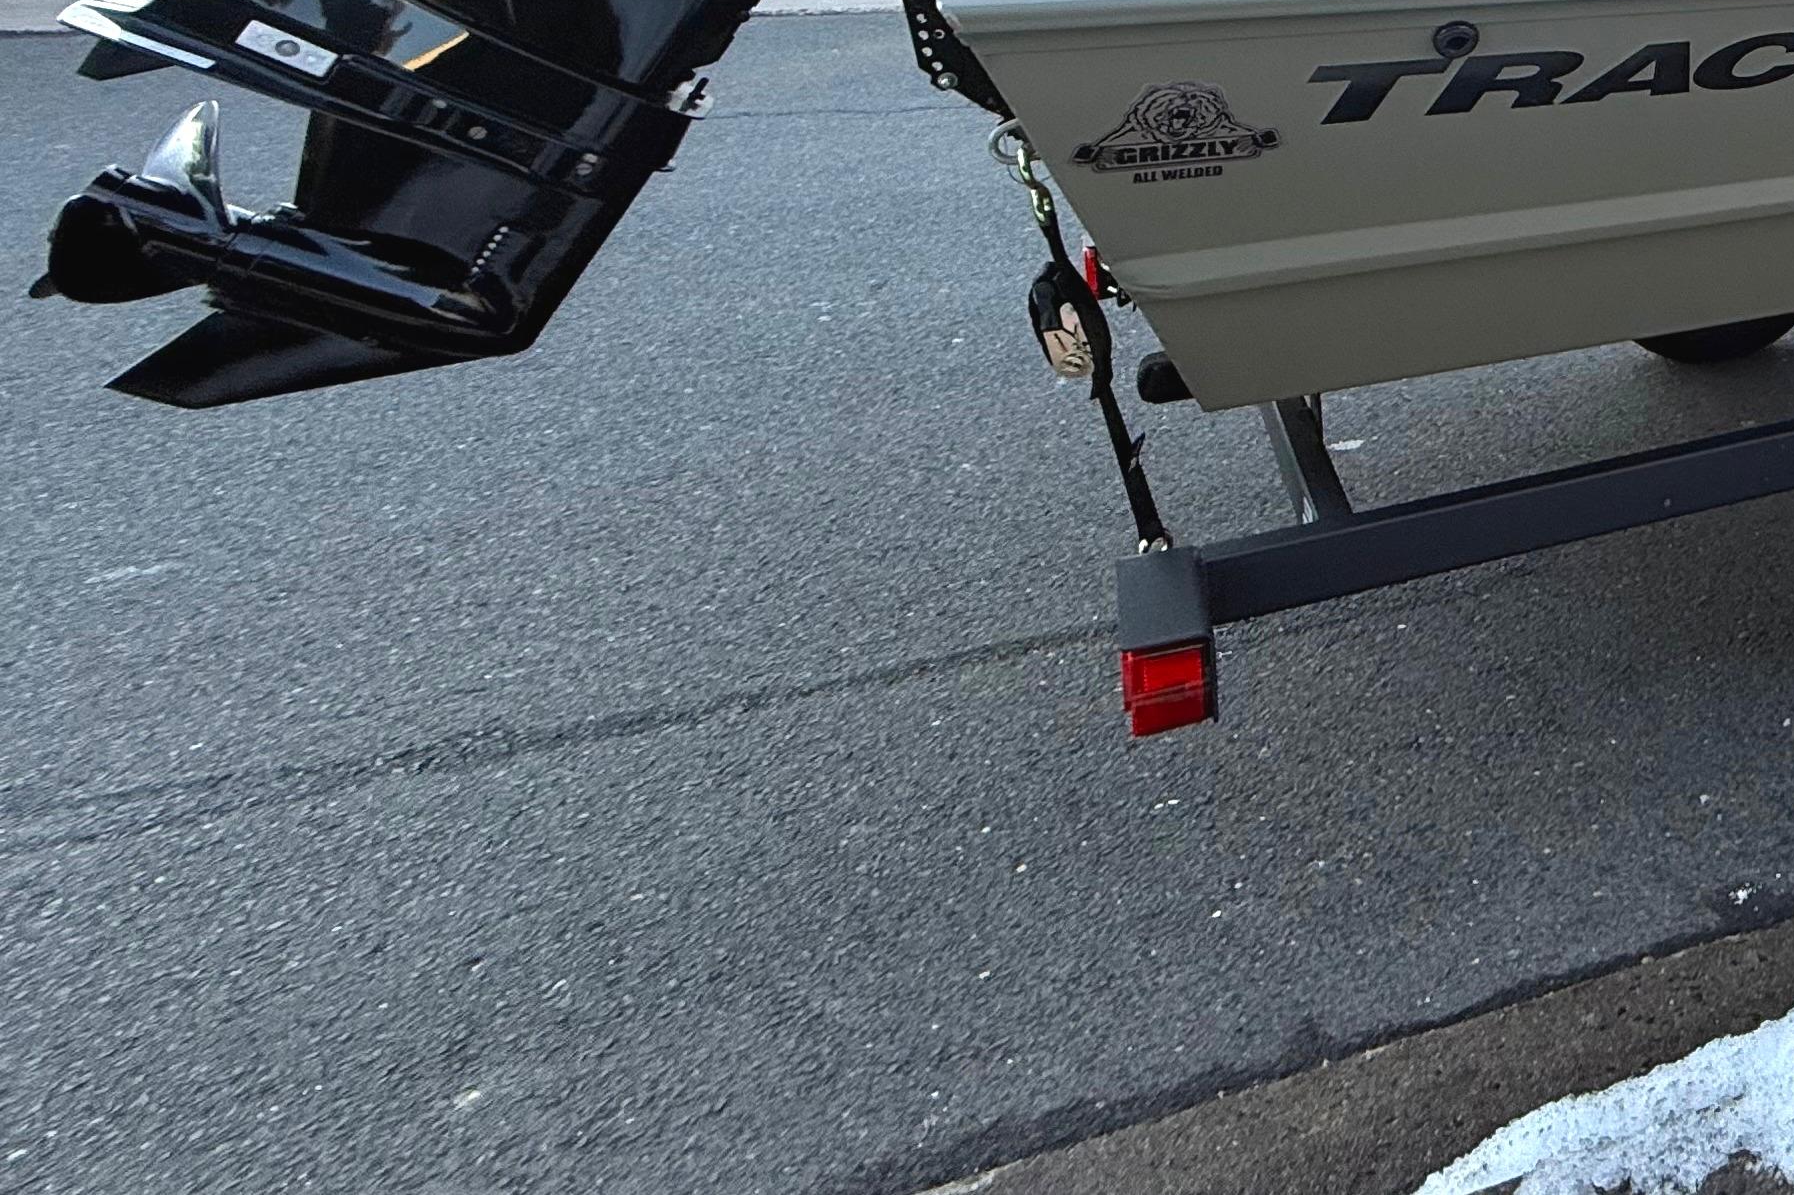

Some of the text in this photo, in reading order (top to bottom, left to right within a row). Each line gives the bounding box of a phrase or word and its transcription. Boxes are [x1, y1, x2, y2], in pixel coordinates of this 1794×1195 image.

[1115, 139, 1239, 164] GRIZZLY
[1132, 165, 1223, 184] ALL WELDED
